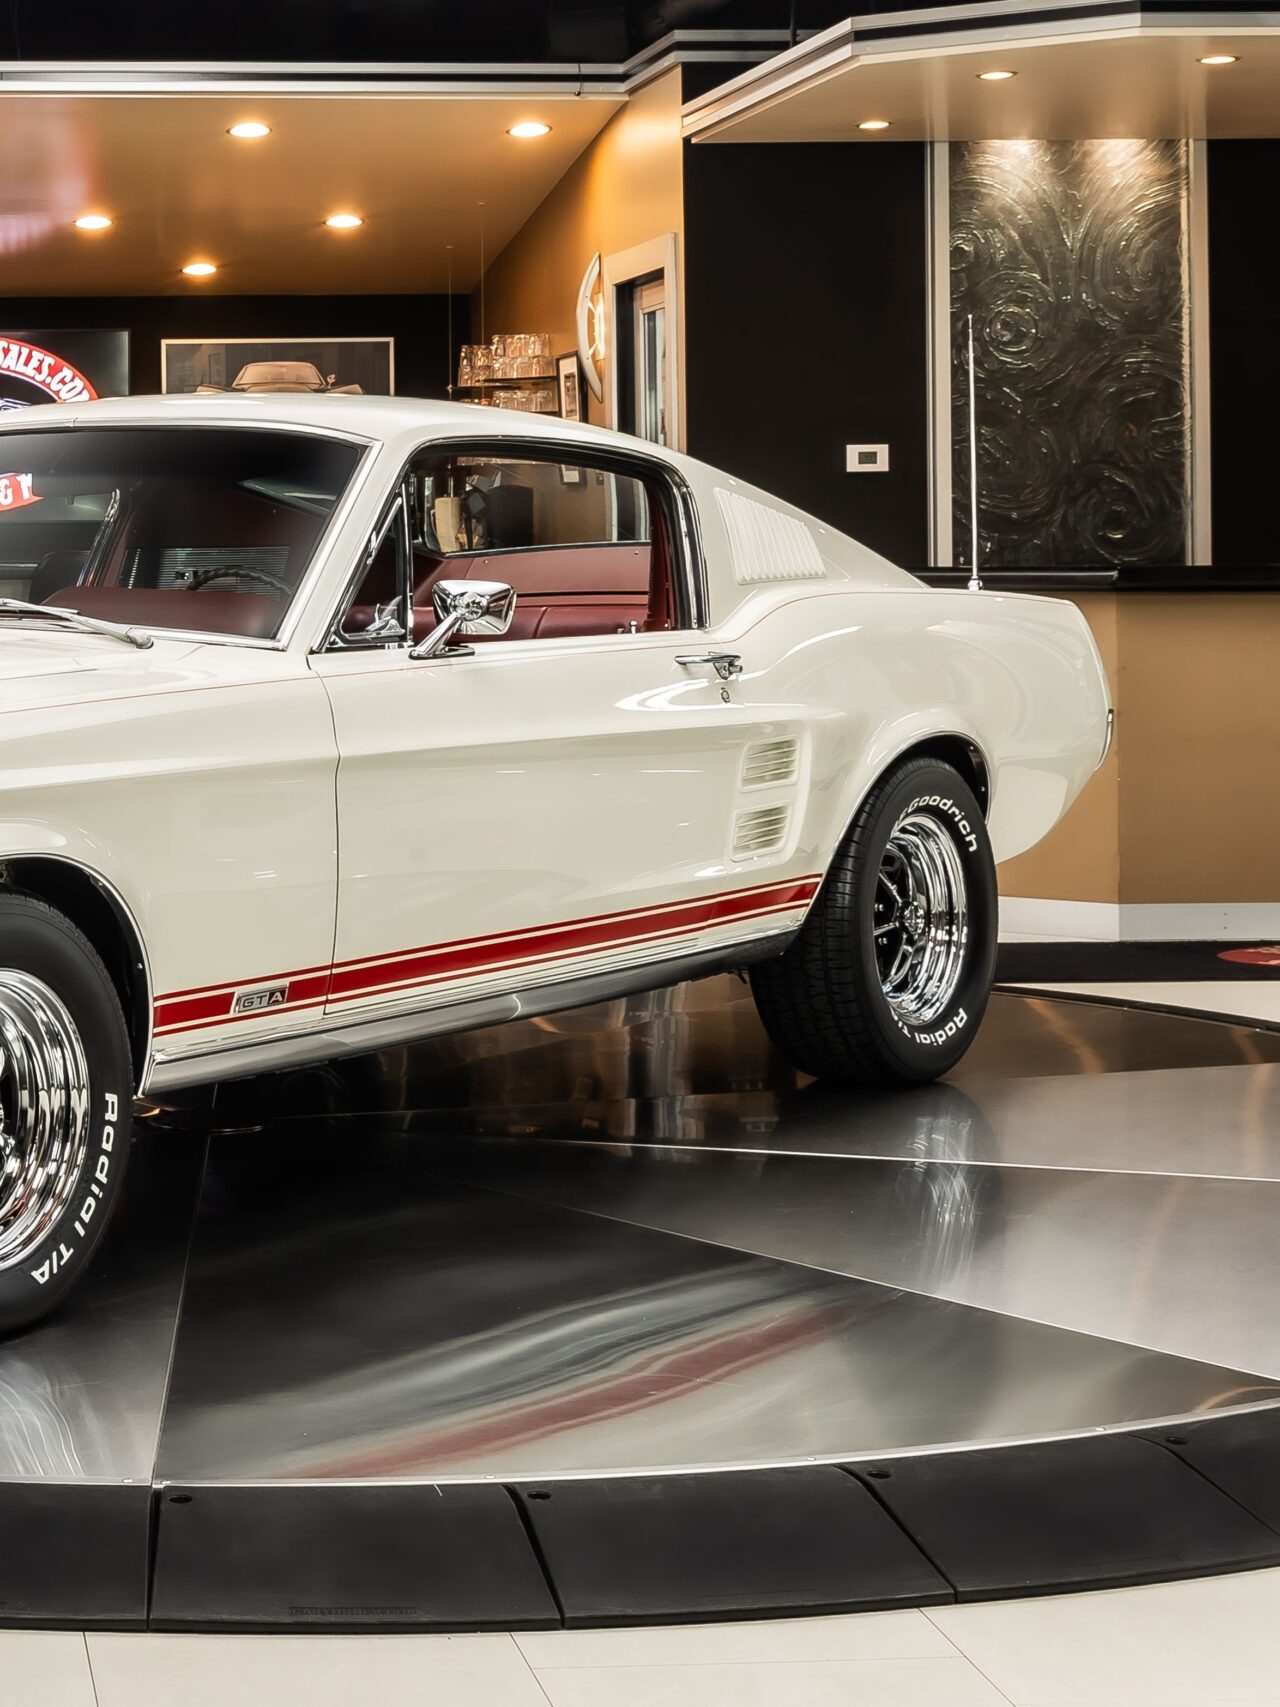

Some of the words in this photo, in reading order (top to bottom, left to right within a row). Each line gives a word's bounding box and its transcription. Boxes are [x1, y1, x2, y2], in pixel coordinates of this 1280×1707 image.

[242, 991, 283, 1008] GTA
[915, 1008, 968, 1046] Radial
[74, 1093, 119, 1238] Radial
[31, 1242, 75, 1285] T/A
